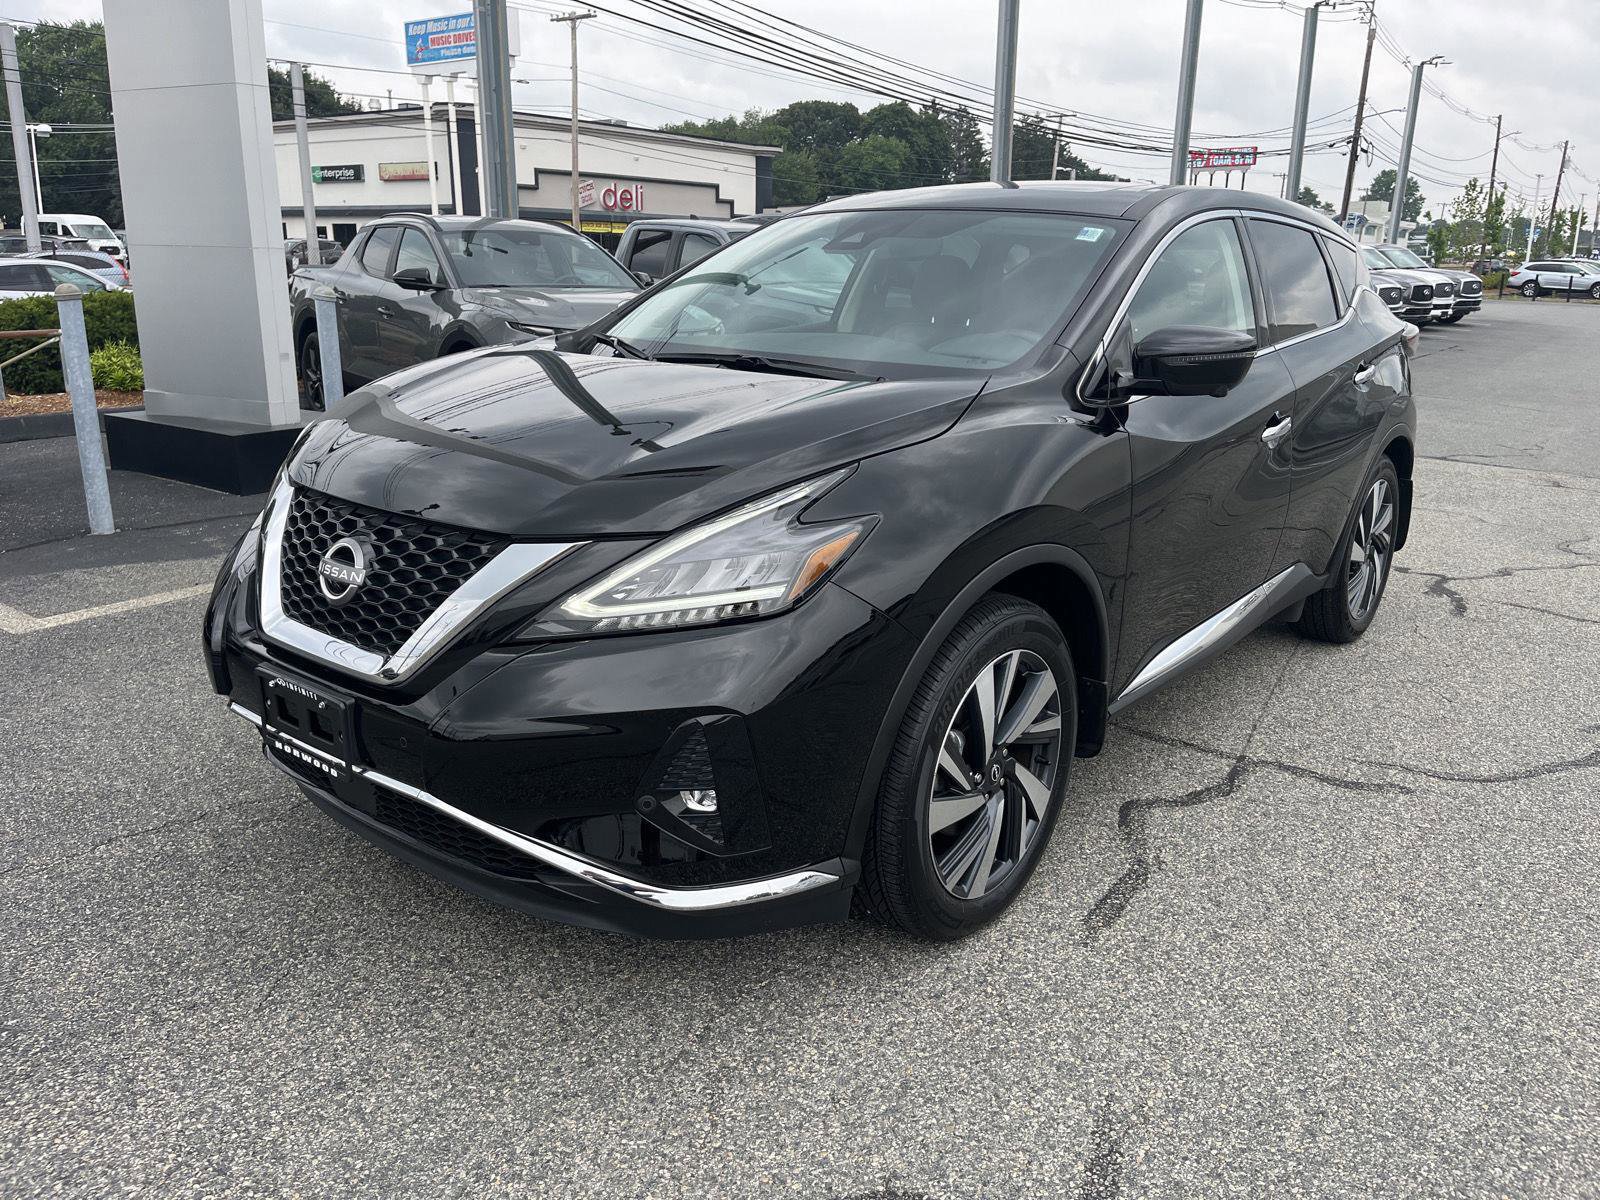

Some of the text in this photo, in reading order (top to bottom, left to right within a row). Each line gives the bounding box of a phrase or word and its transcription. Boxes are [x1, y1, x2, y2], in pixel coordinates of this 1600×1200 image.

[408, 23, 426, 36] Keep
[427, 19, 448, 33] Music
[430, 34, 452, 48] MUSIC
[313, 167, 355, 179] enterprise
[600, 181, 644, 211] deli
[319, 562, 363, 583] ISSAN
[286, 681, 318, 701] INFINITI
[275, 740, 338, 778] NORWOOD
